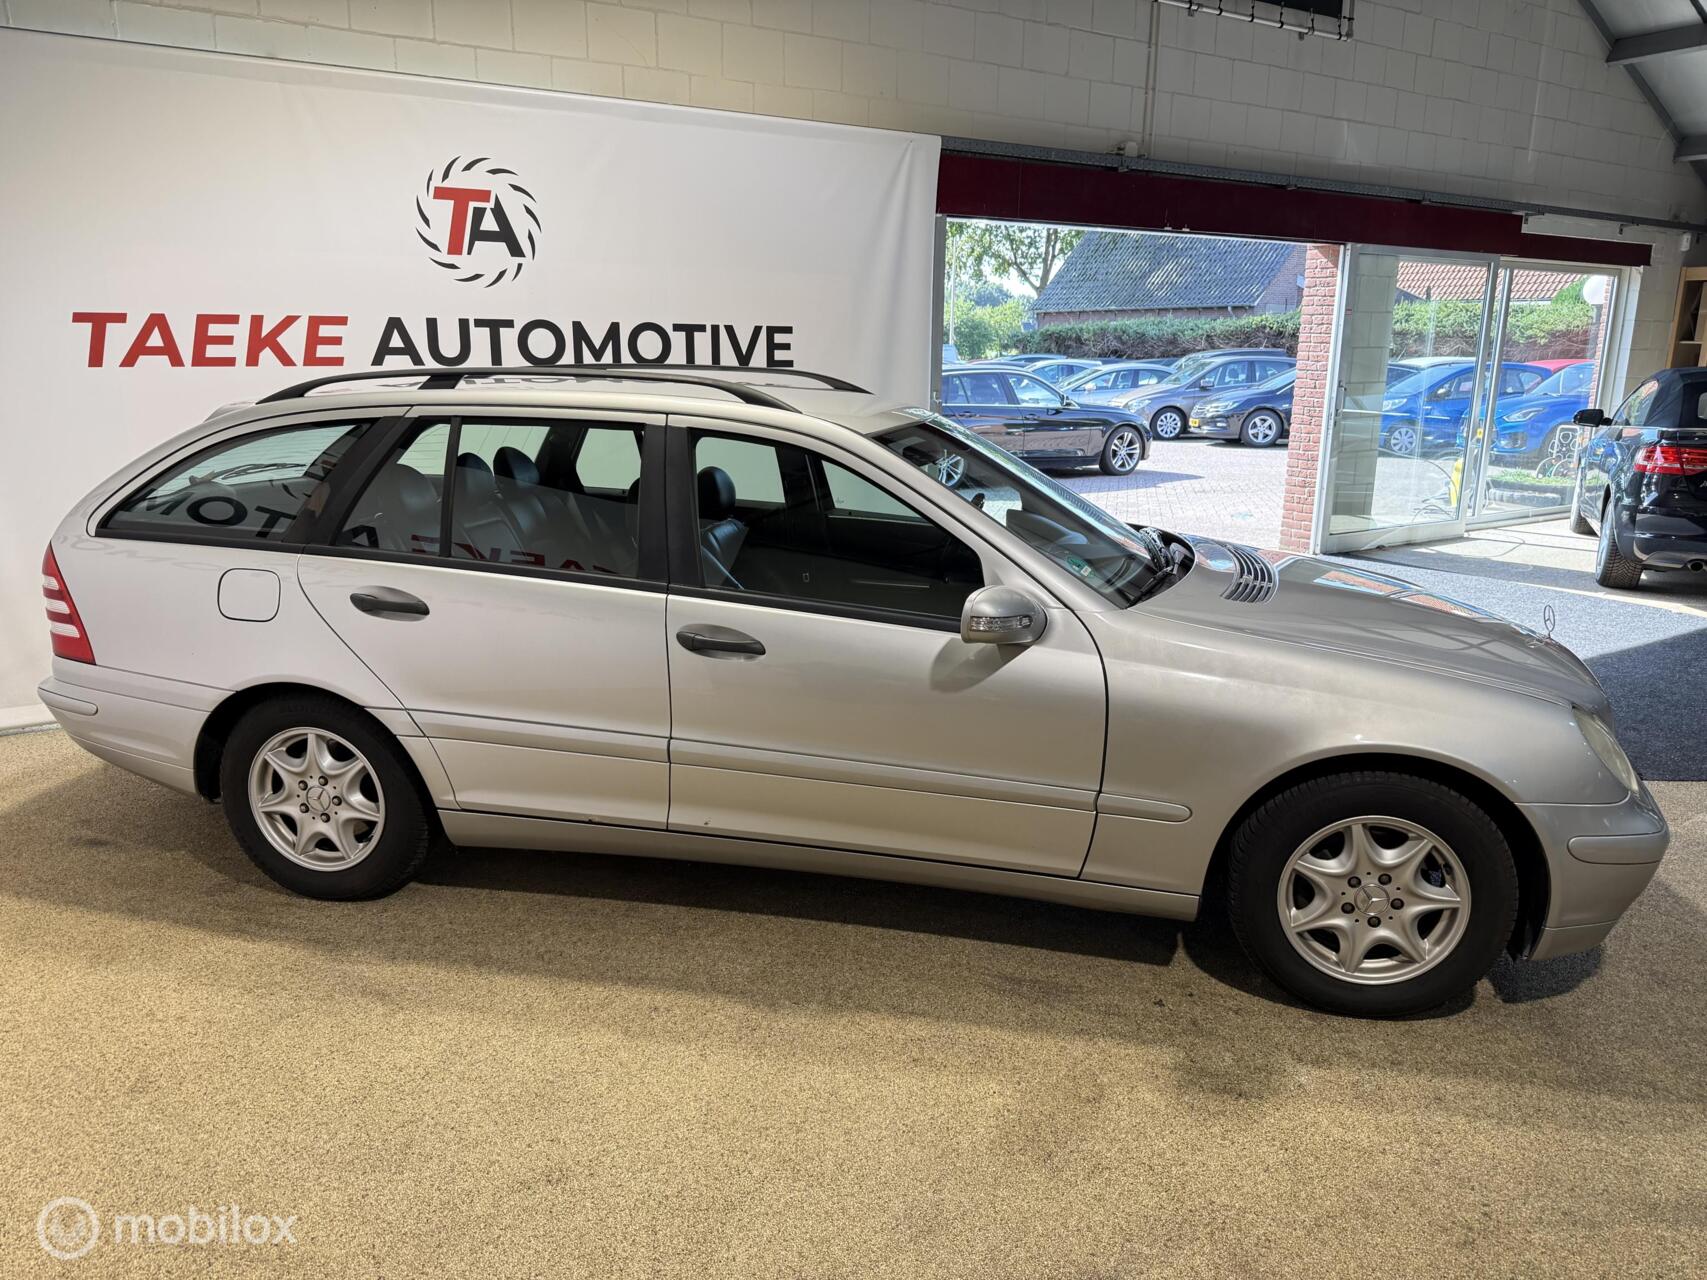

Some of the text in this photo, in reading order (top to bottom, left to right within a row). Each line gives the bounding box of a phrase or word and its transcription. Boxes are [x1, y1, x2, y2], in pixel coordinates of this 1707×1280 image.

[432, 186, 526, 258] TA
[72, 312, 795, 368] TAEKE AUTOMOTIVE
